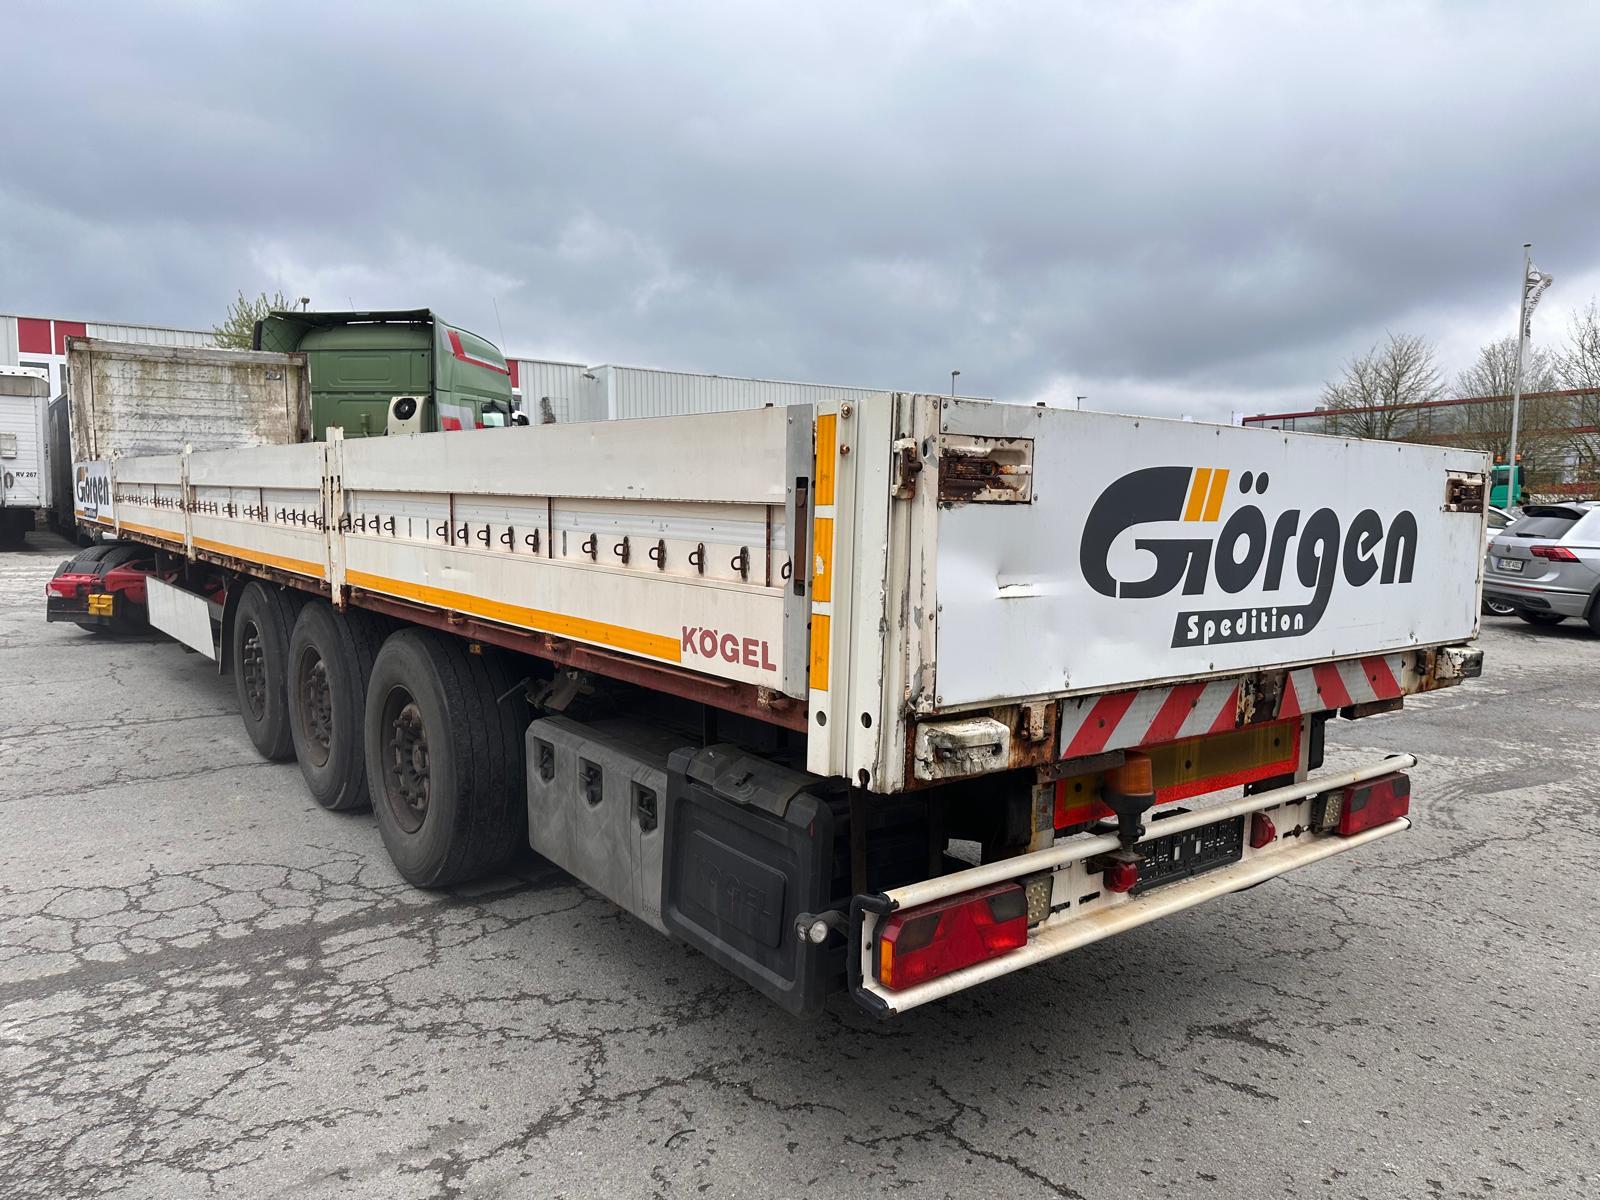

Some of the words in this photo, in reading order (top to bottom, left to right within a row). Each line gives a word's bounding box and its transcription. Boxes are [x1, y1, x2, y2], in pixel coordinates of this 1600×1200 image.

[1079, 465, 1418, 622] Görgen
[681, 625, 778, 672] KÖGEL
[1186, 606, 1305, 645] Spedition
